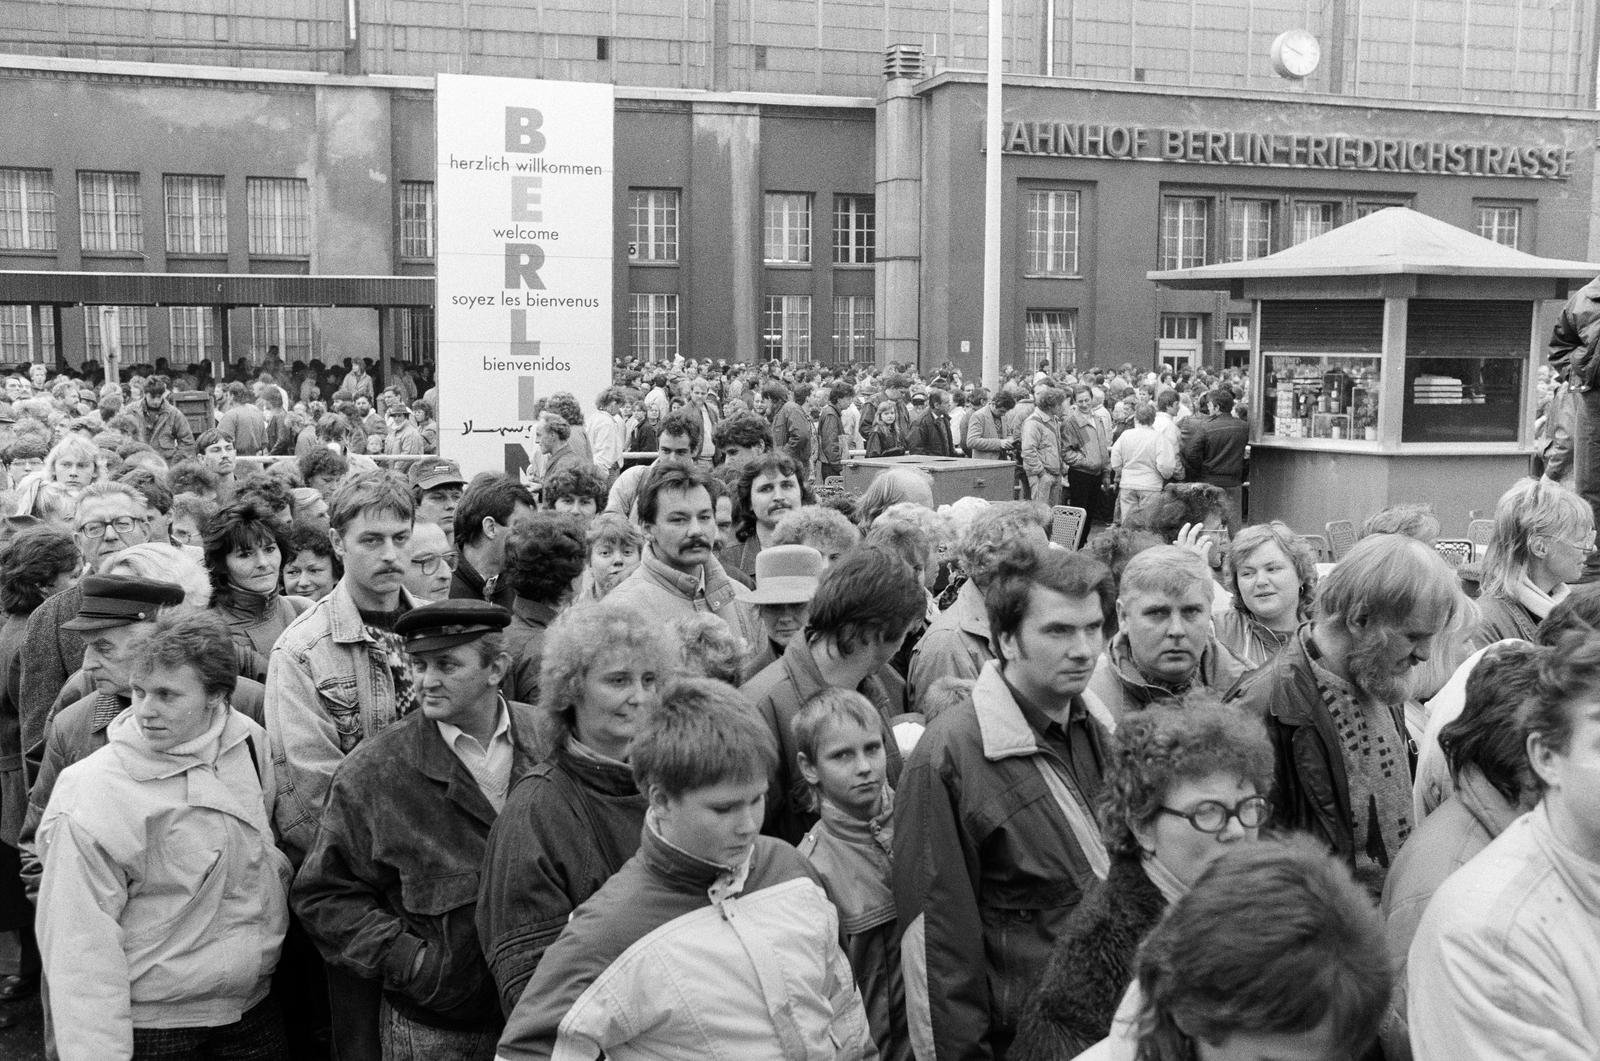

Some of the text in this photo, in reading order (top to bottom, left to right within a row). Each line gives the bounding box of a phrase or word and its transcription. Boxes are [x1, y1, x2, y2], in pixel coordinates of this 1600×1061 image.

[450, 153, 602, 176] herzlich willkommen
[493, 224, 559, 241] welcome
[452, 291, 600, 309] soyez les bienvenus
[483, 356, 571, 372] bienvenidos
